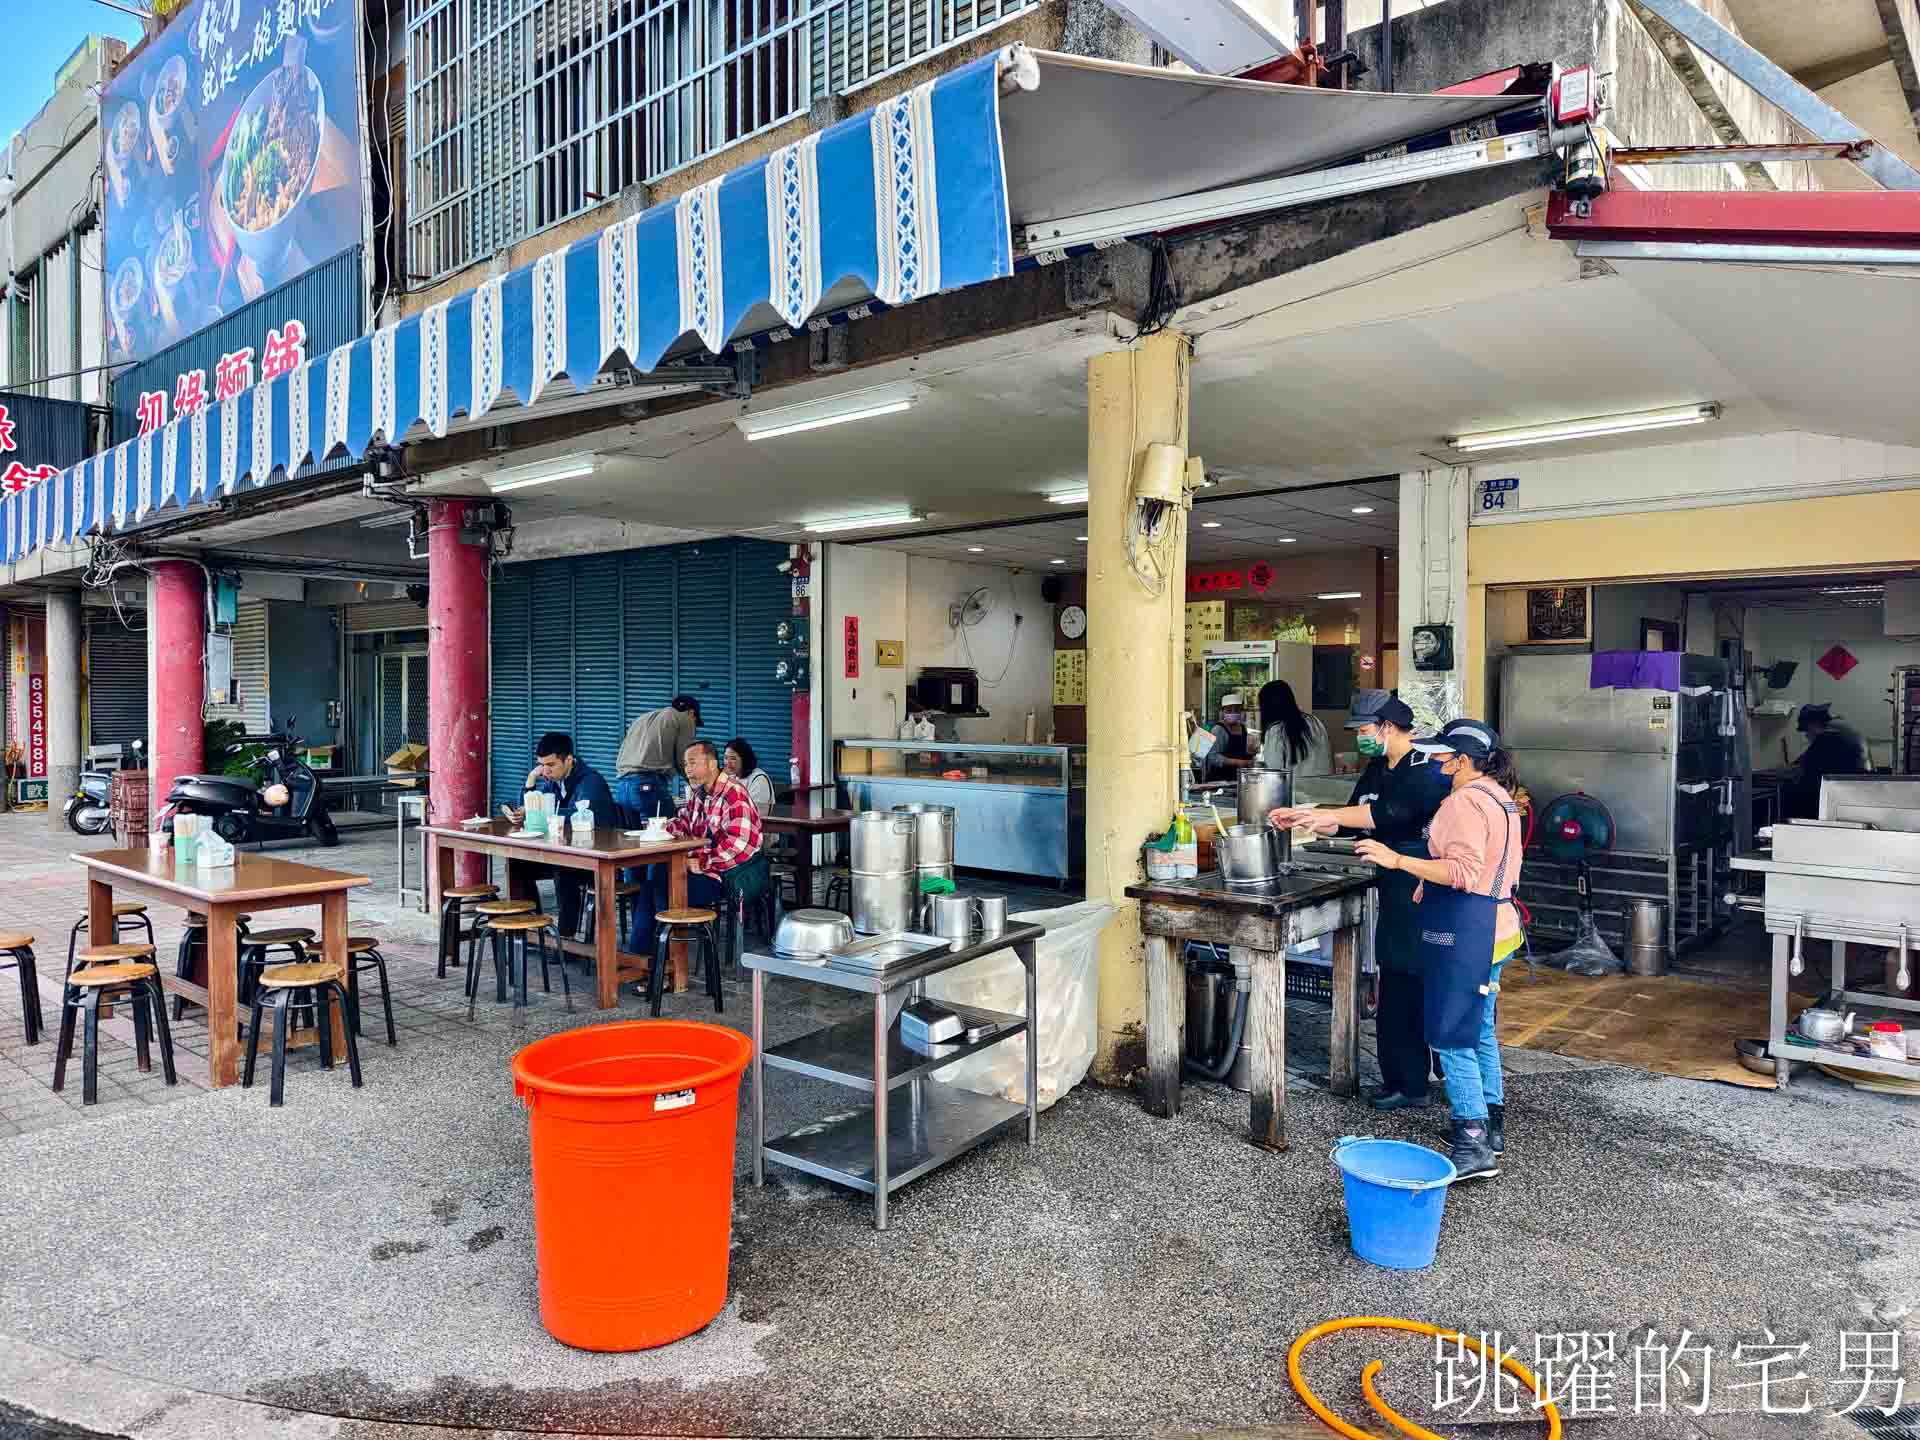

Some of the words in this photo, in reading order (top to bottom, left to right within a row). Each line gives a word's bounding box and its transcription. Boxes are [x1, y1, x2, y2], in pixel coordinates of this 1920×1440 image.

[1483, 492, 1505, 509] 84
[795, 585, 806, 597] 86
[32, 677, 44, 774] 8354588
